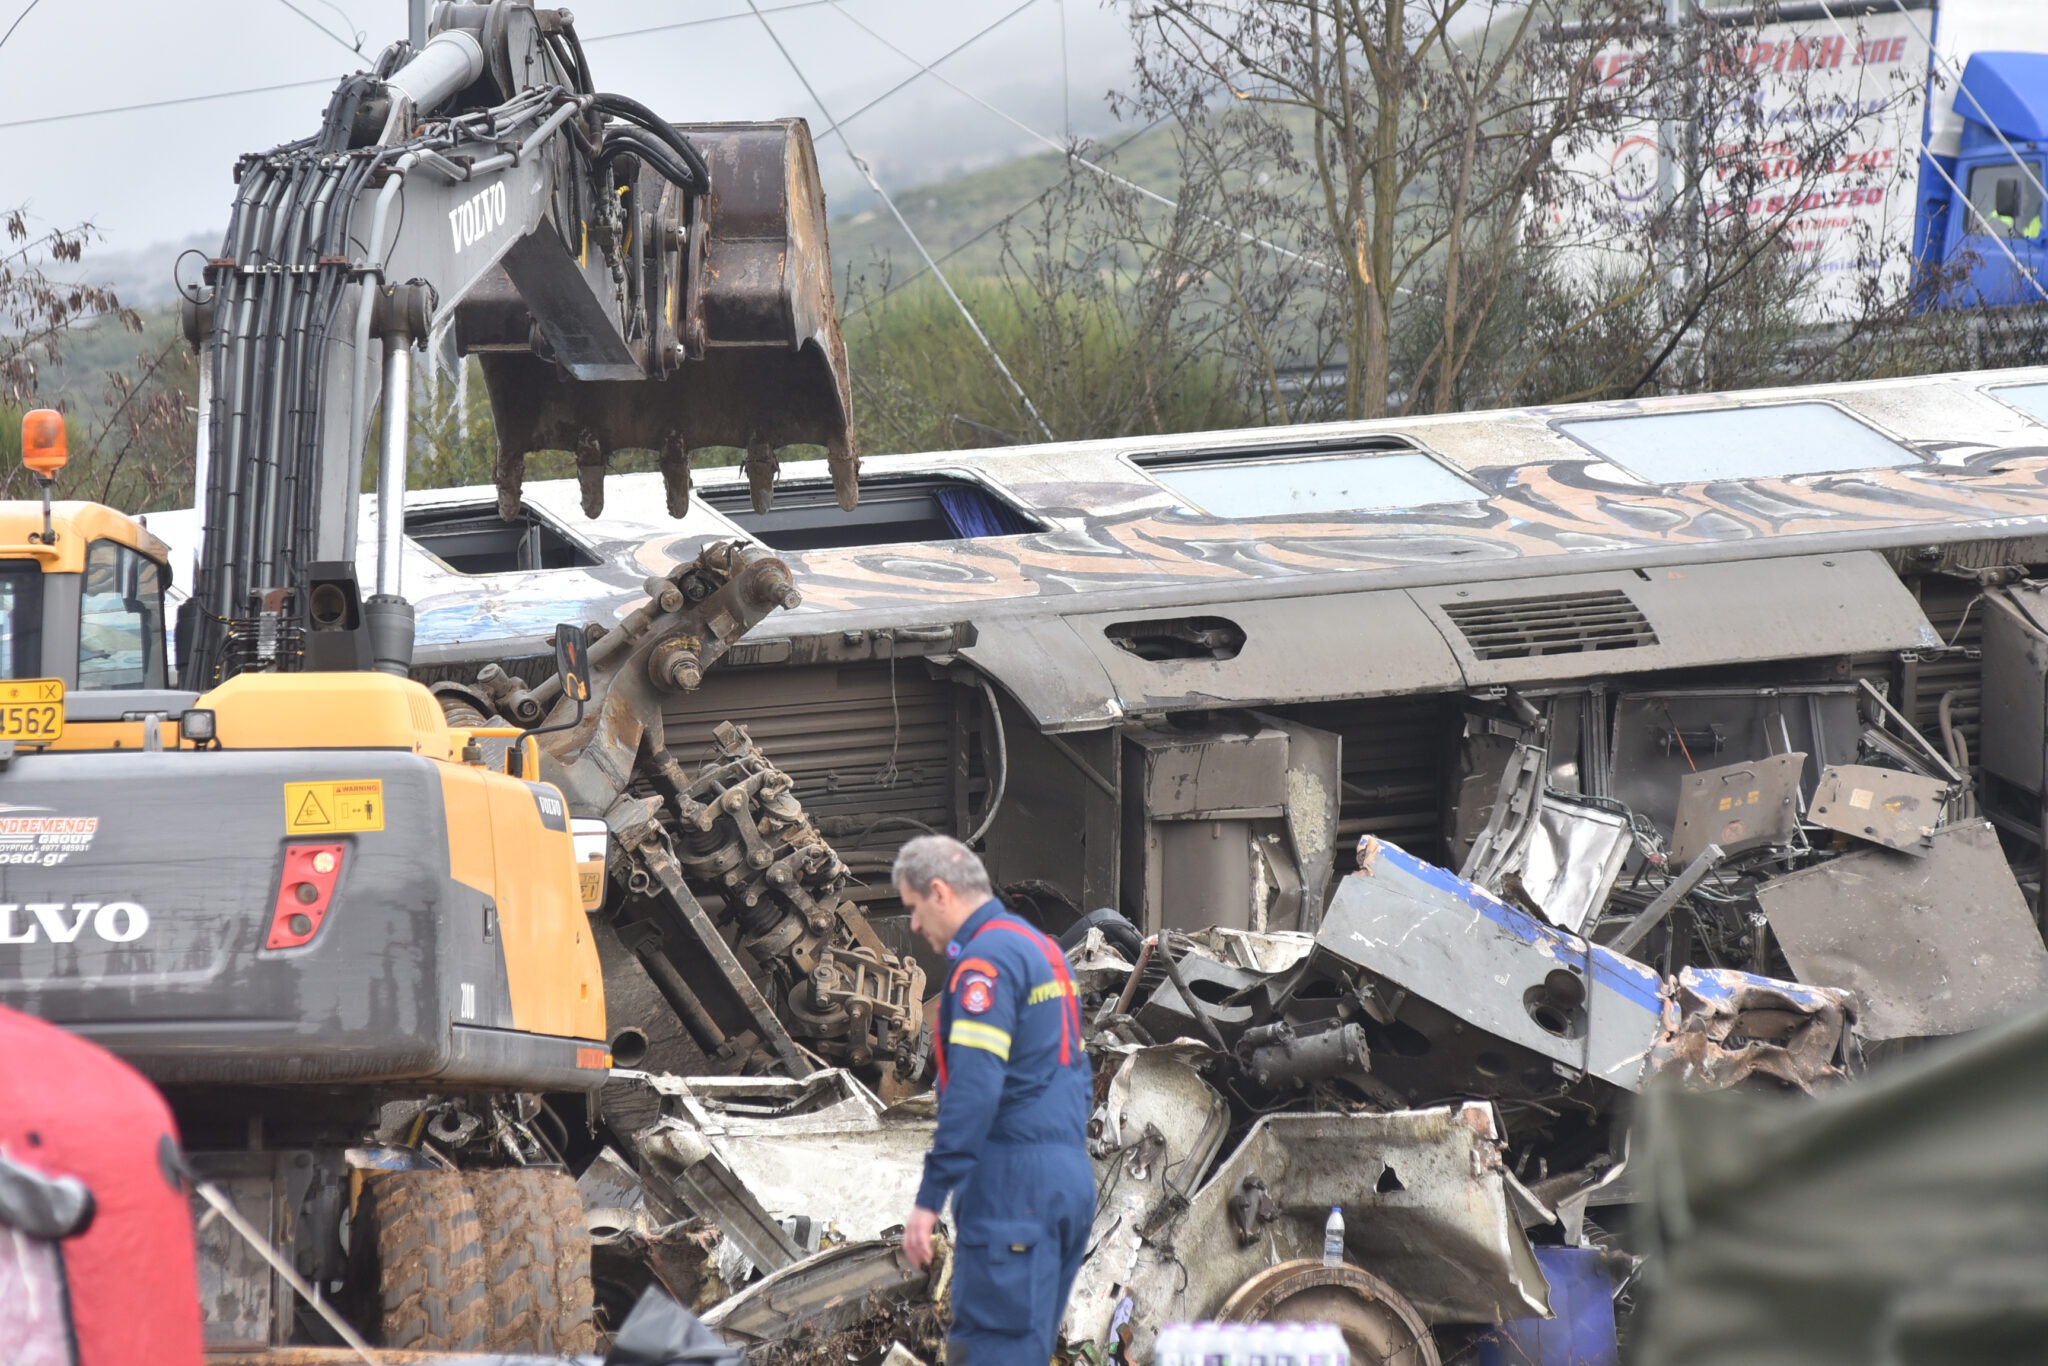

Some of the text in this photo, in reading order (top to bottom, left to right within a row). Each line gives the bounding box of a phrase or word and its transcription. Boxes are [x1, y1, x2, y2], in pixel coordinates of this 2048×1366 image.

[449, 180, 506, 254] VOLVO
[343, 784, 377, 793] WARNING
[538, 796, 562, 817] VOLVO
[39, 834, 94, 844] GROUP
